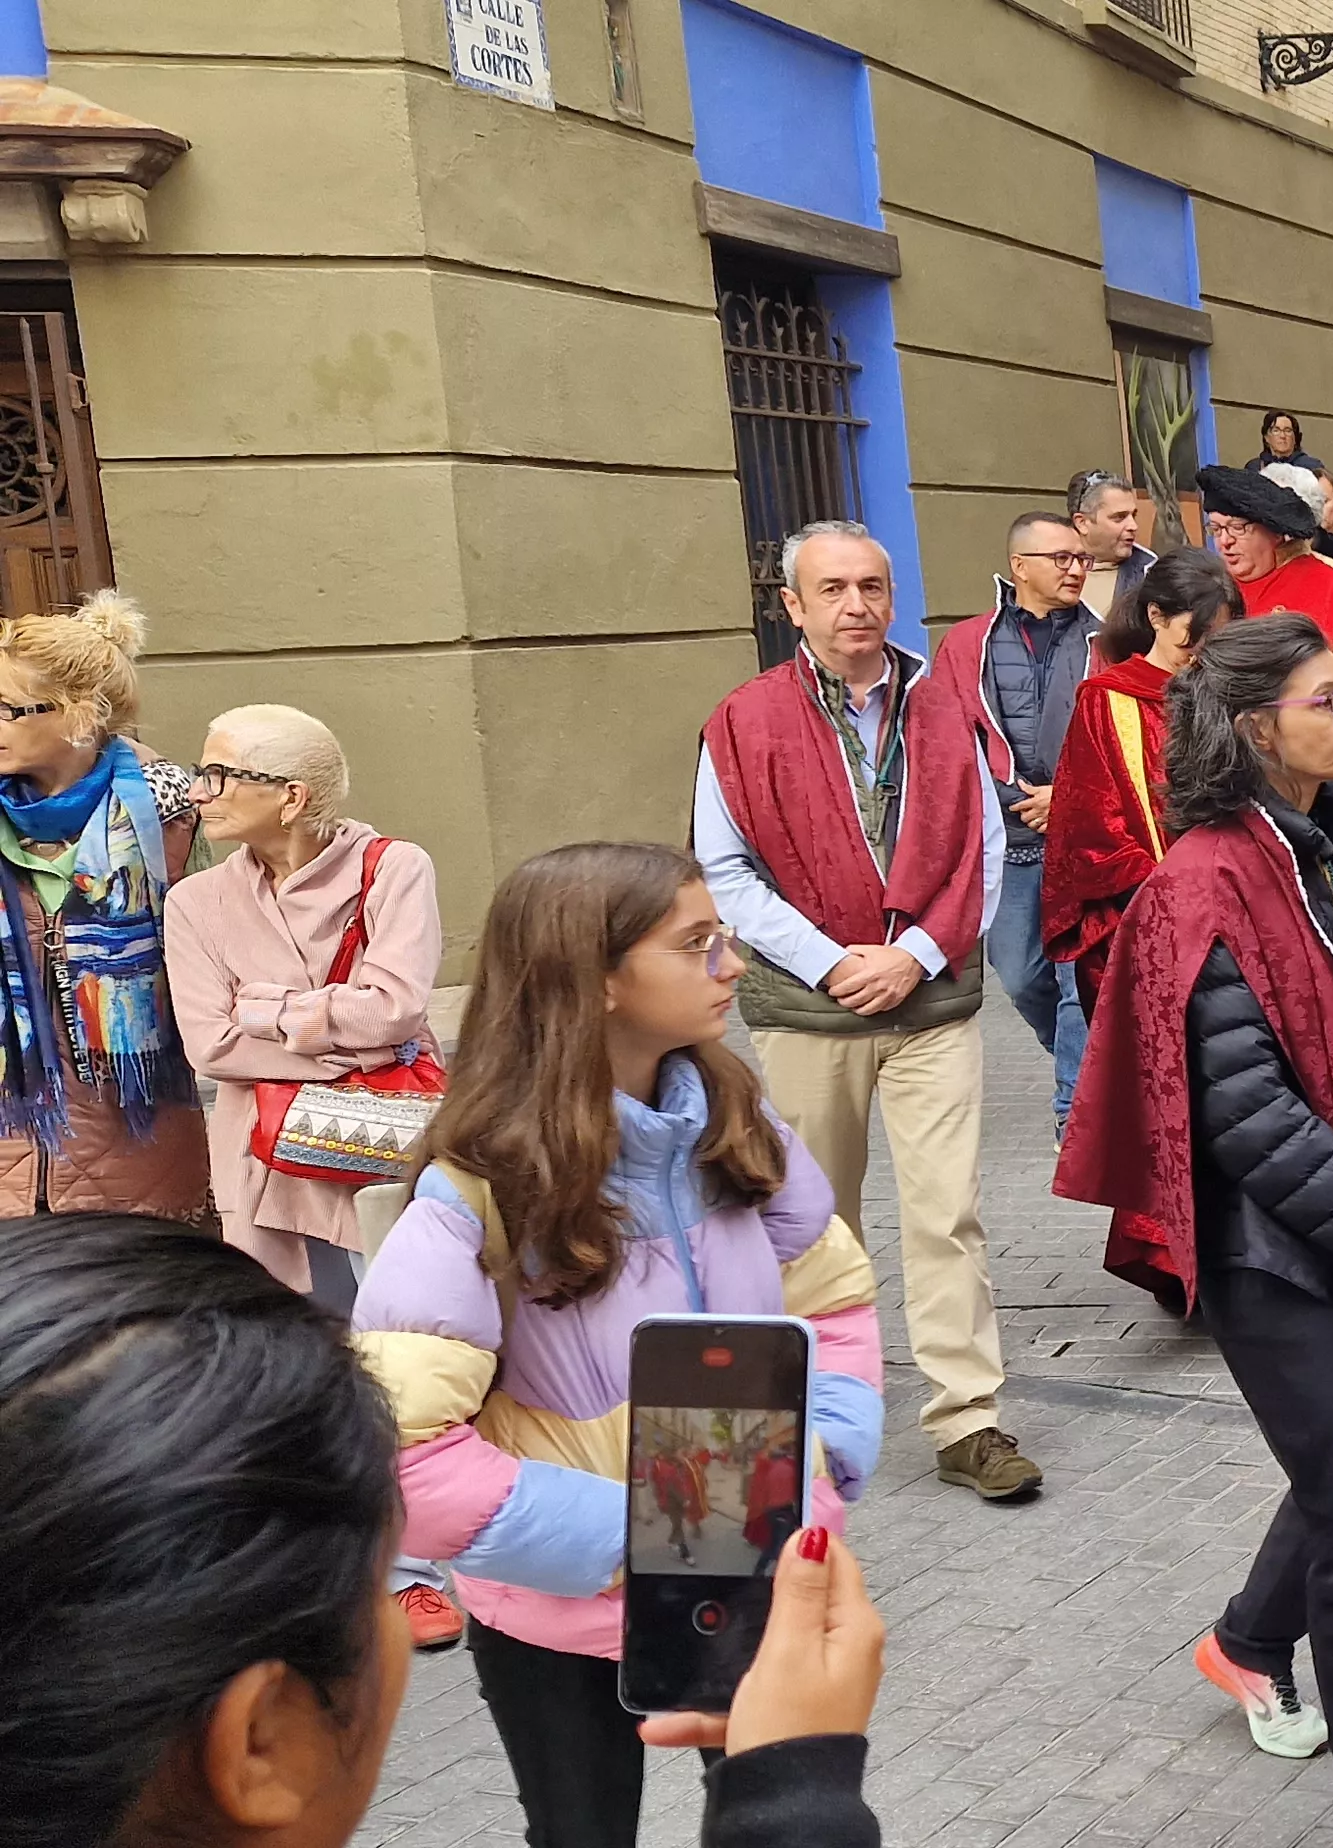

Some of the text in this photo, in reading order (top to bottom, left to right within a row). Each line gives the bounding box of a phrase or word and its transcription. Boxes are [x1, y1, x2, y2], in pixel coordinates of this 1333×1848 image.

[479, 0, 524, 27] CALLE
[484, 24, 528, 55] DE LAS
[471, 44, 533, 86] CORTES
